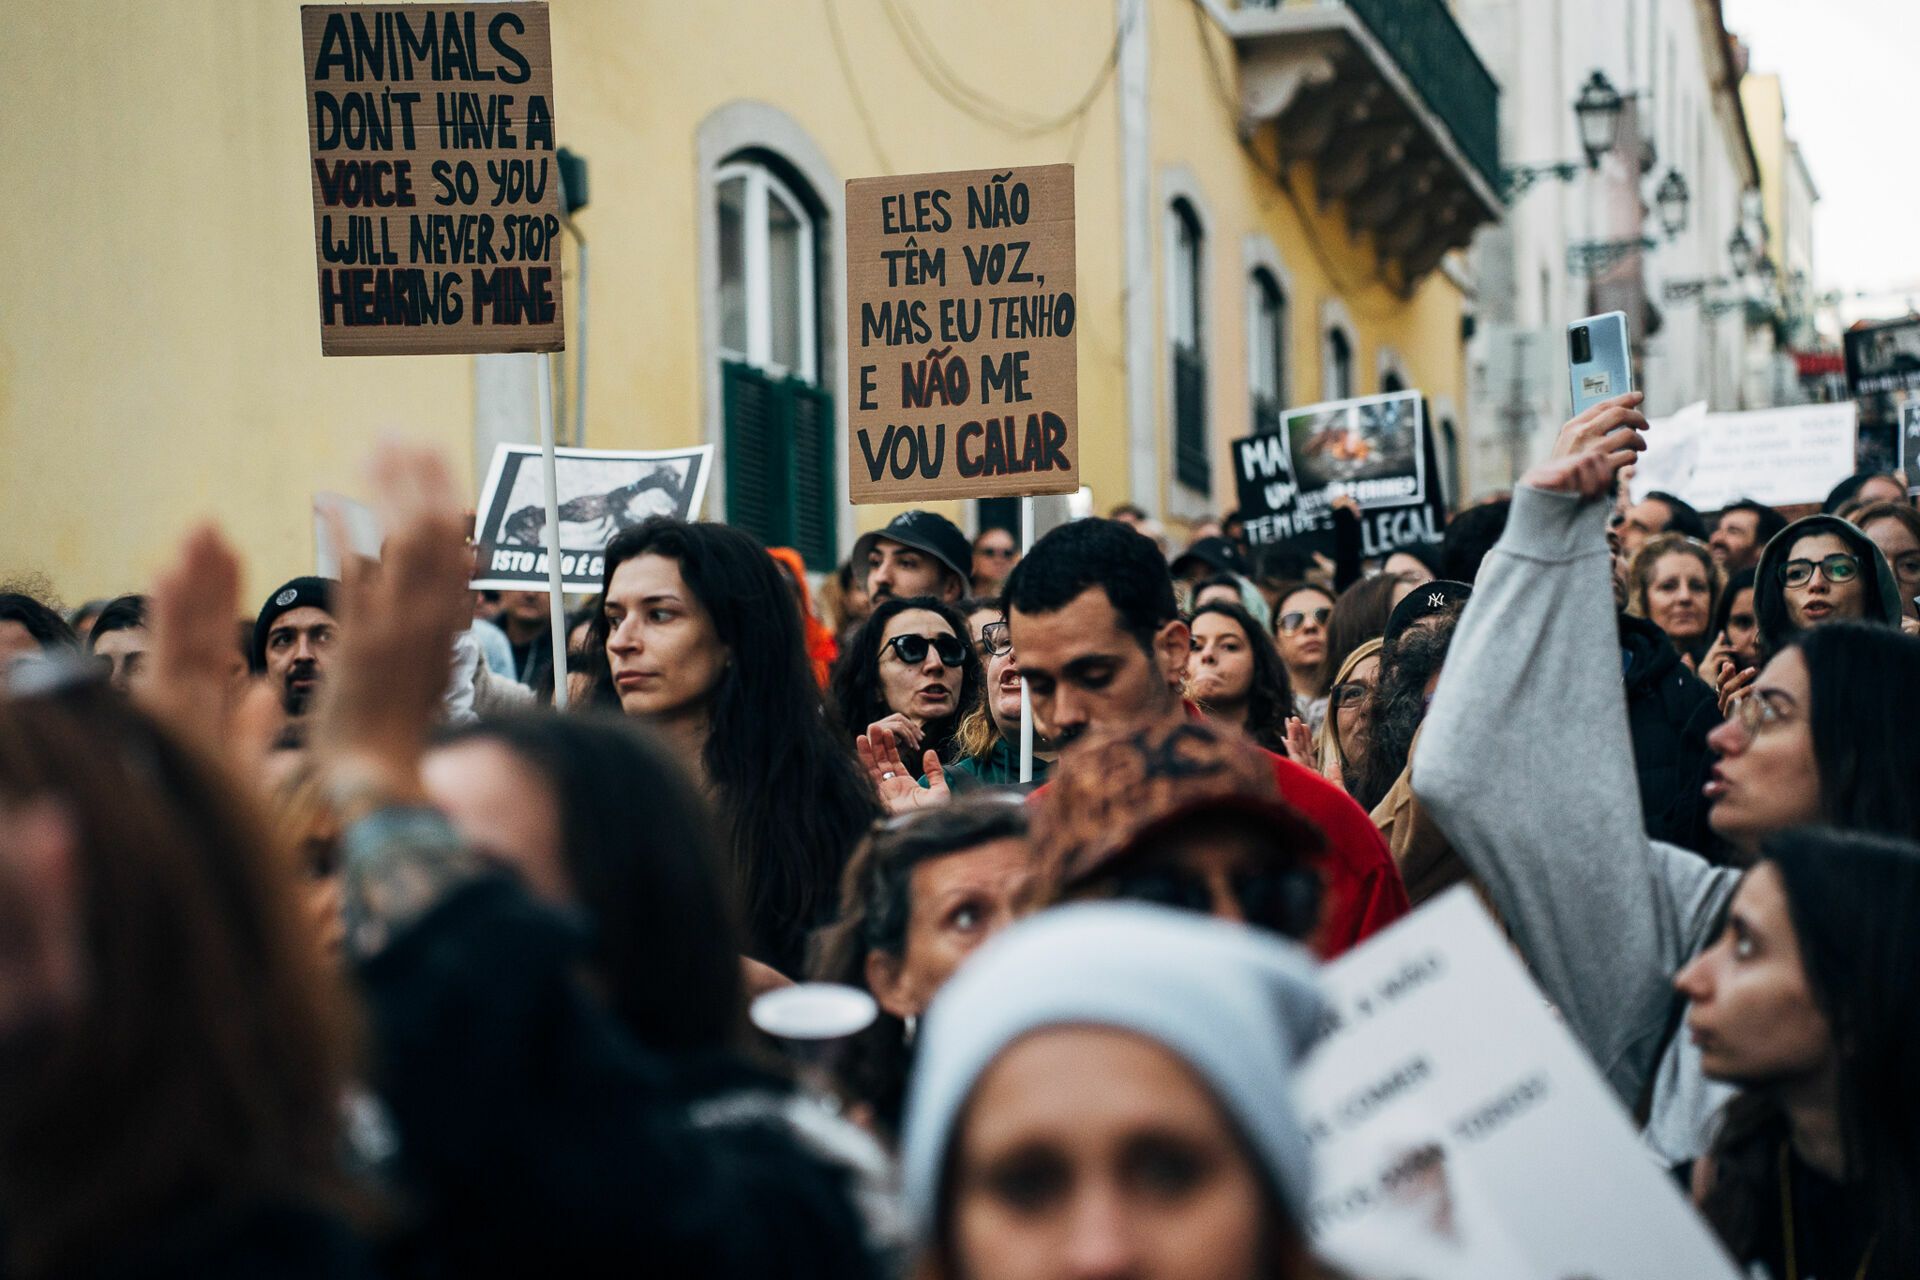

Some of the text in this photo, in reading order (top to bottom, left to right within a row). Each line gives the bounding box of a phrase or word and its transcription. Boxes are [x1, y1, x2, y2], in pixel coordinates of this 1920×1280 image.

[314, 11, 532, 84] ANIMALS
[314, 86, 554, 151] DON'T HAVE A
[314, 157, 548, 208] VOICE SO YOU
[881, 171, 1030, 235] ELES NÃO
[322, 214, 560, 265] WILL NEVER STOP
[880, 235, 1045, 288] TÊM VOZ,
[322, 267, 556, 326] HEARING MINE
[861, 292, 1075, 347] MAS EU TENHO
[859, 345, 1033, 411] E NÃO ME
[857, 411, 1071, 482] VOU CALAR
[490, 549, 536, 574] ISTO
[534, 551, 576, 576] NO
[1427, 592, 1445, 607] NY
